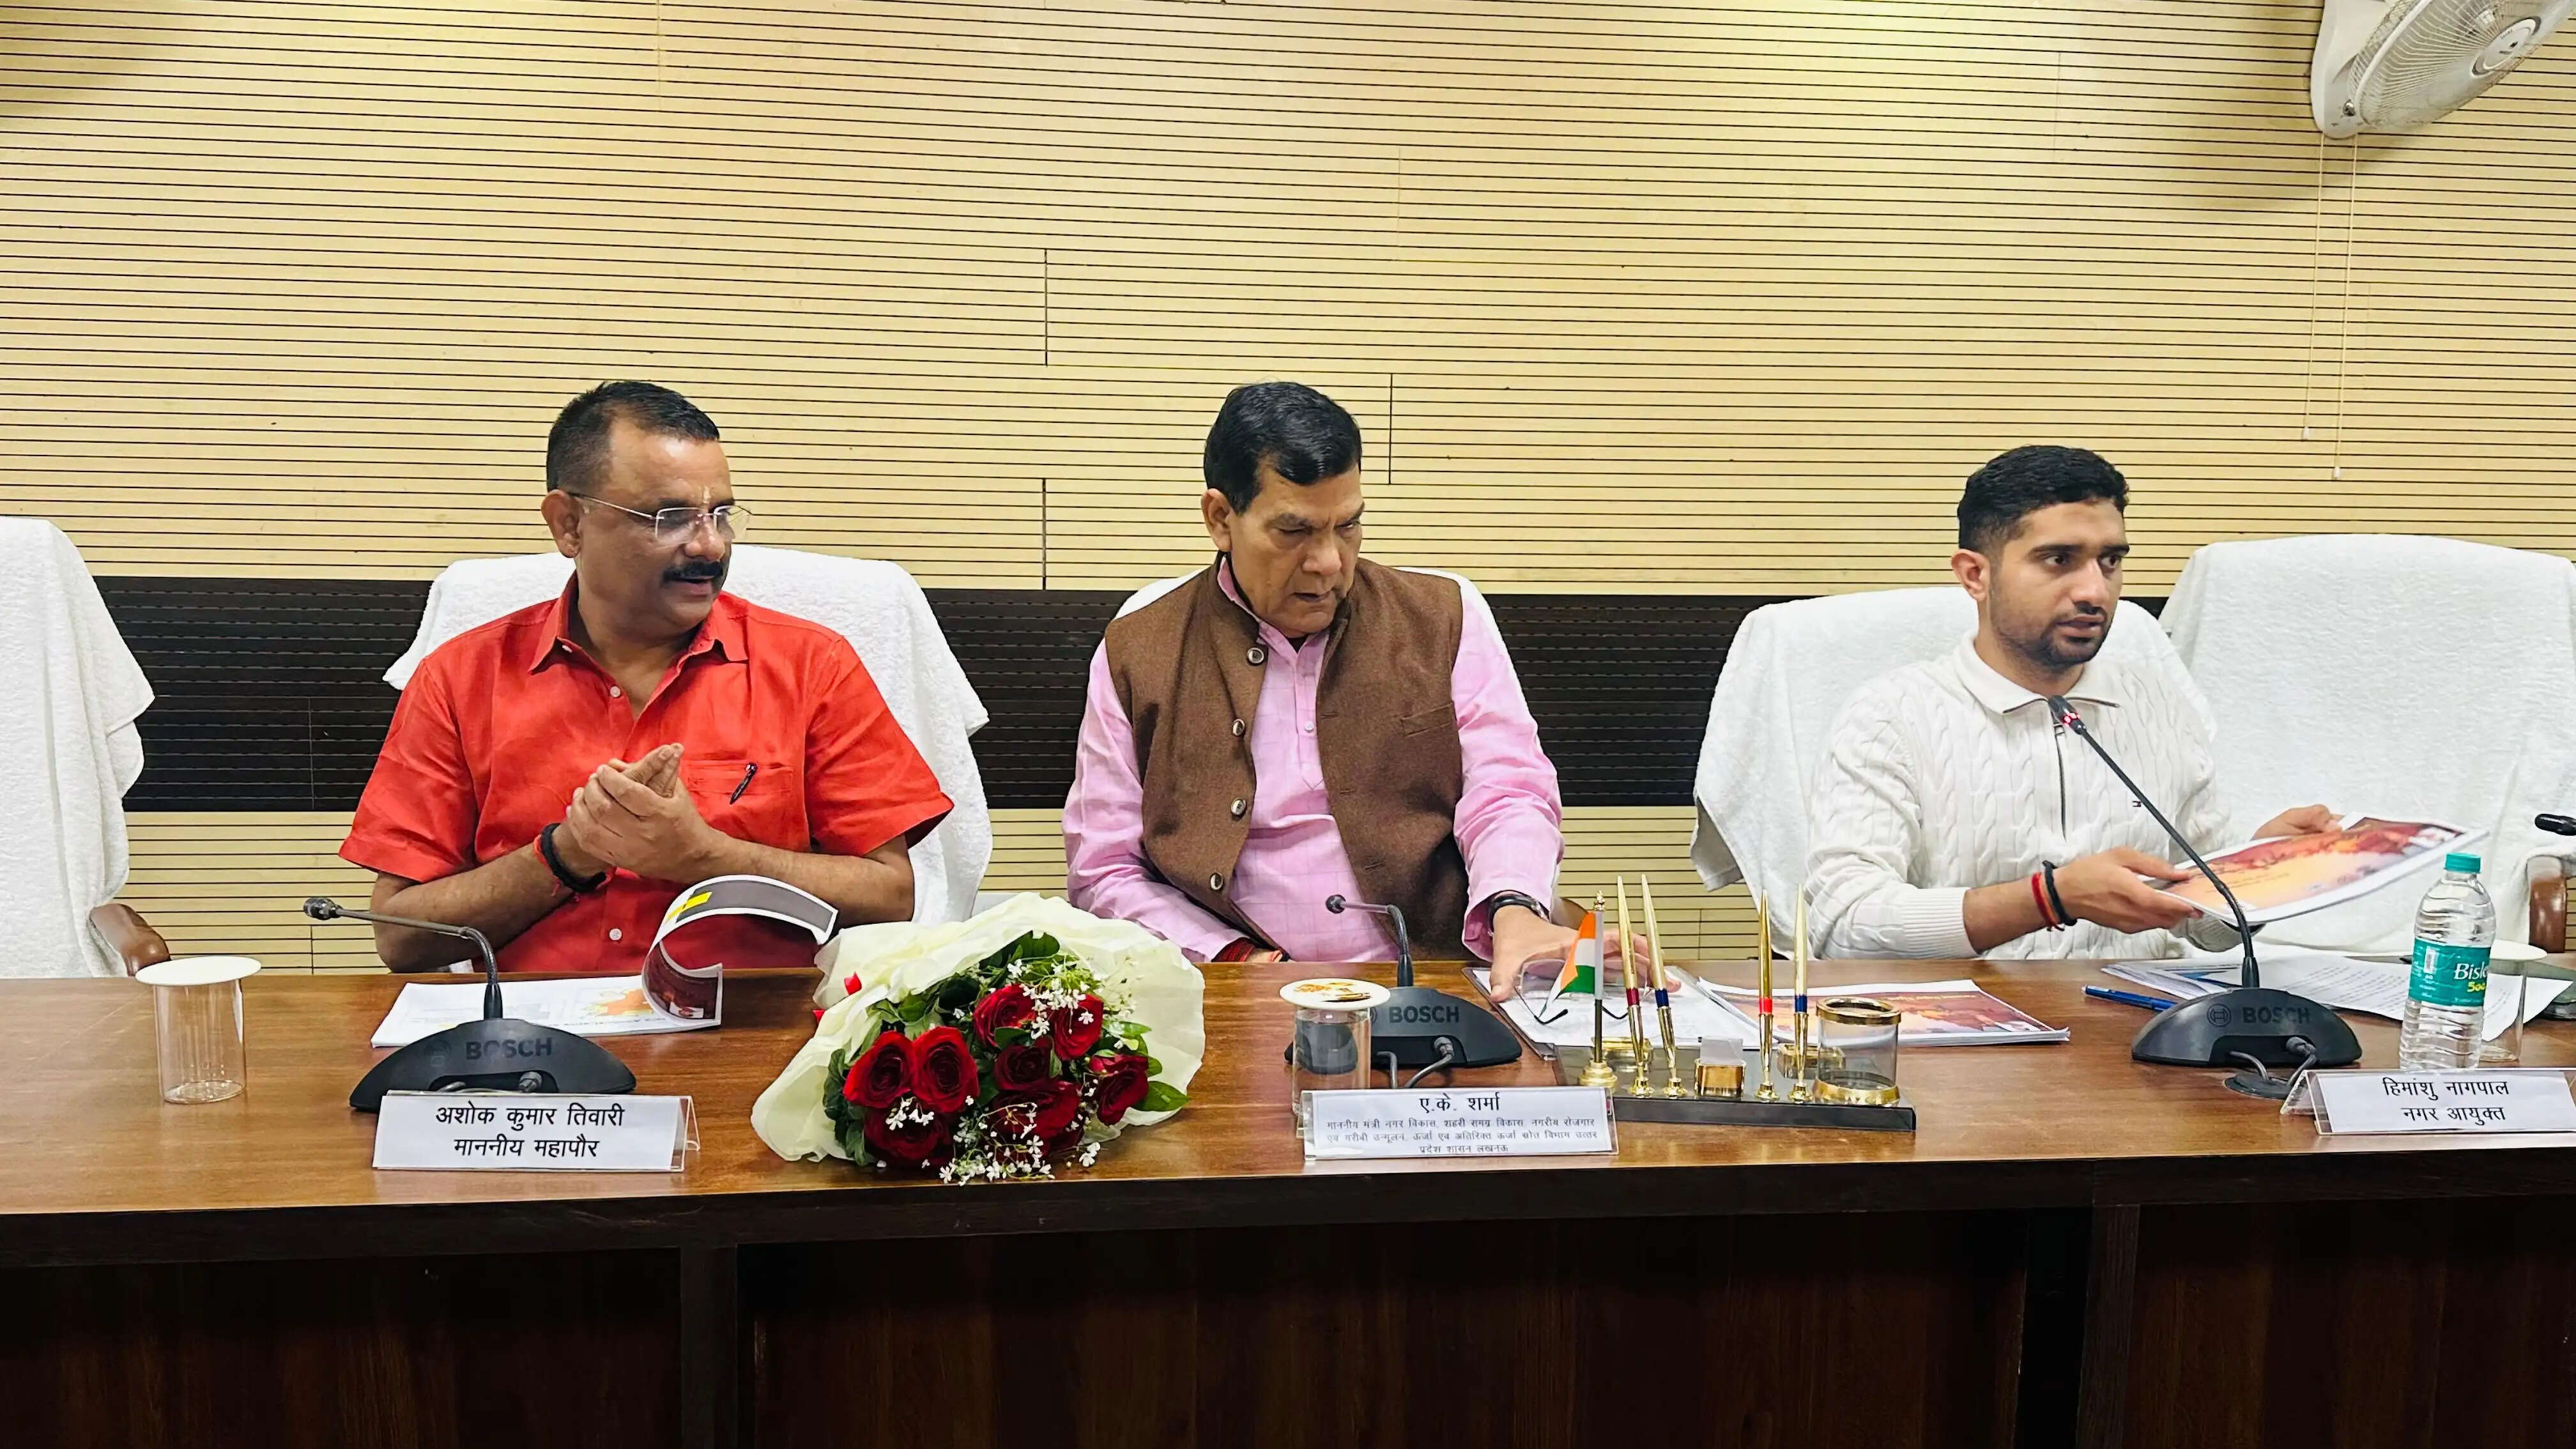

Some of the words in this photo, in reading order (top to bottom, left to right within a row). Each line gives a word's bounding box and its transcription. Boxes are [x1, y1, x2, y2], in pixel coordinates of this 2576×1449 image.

[1389, 1006, 1460, 1023] BOSCH
[2242, 1007, 2310, 1023] BOSCH
[465, 1038, 552, 1059] BOSCH
[2382, 1077, 2439, 1101] हिमांशु
[2443, 1081, 2509, 1096] नागपाल
[1467, 1092, 1500, 1110] शर्मा
[436, 1100, 497, 1124] अशोक
[506, 1108, 557, 1131] कुमार
[567, 1102, 625, 1126] तिवारी
[2400, 1107, 2439, 1121] नगर
[2446, 1107, 2506, 1126] आयुक्त
[454, 1133, 525, 1156] माननीय
[535, 1133, 600, 1158] महापौर
